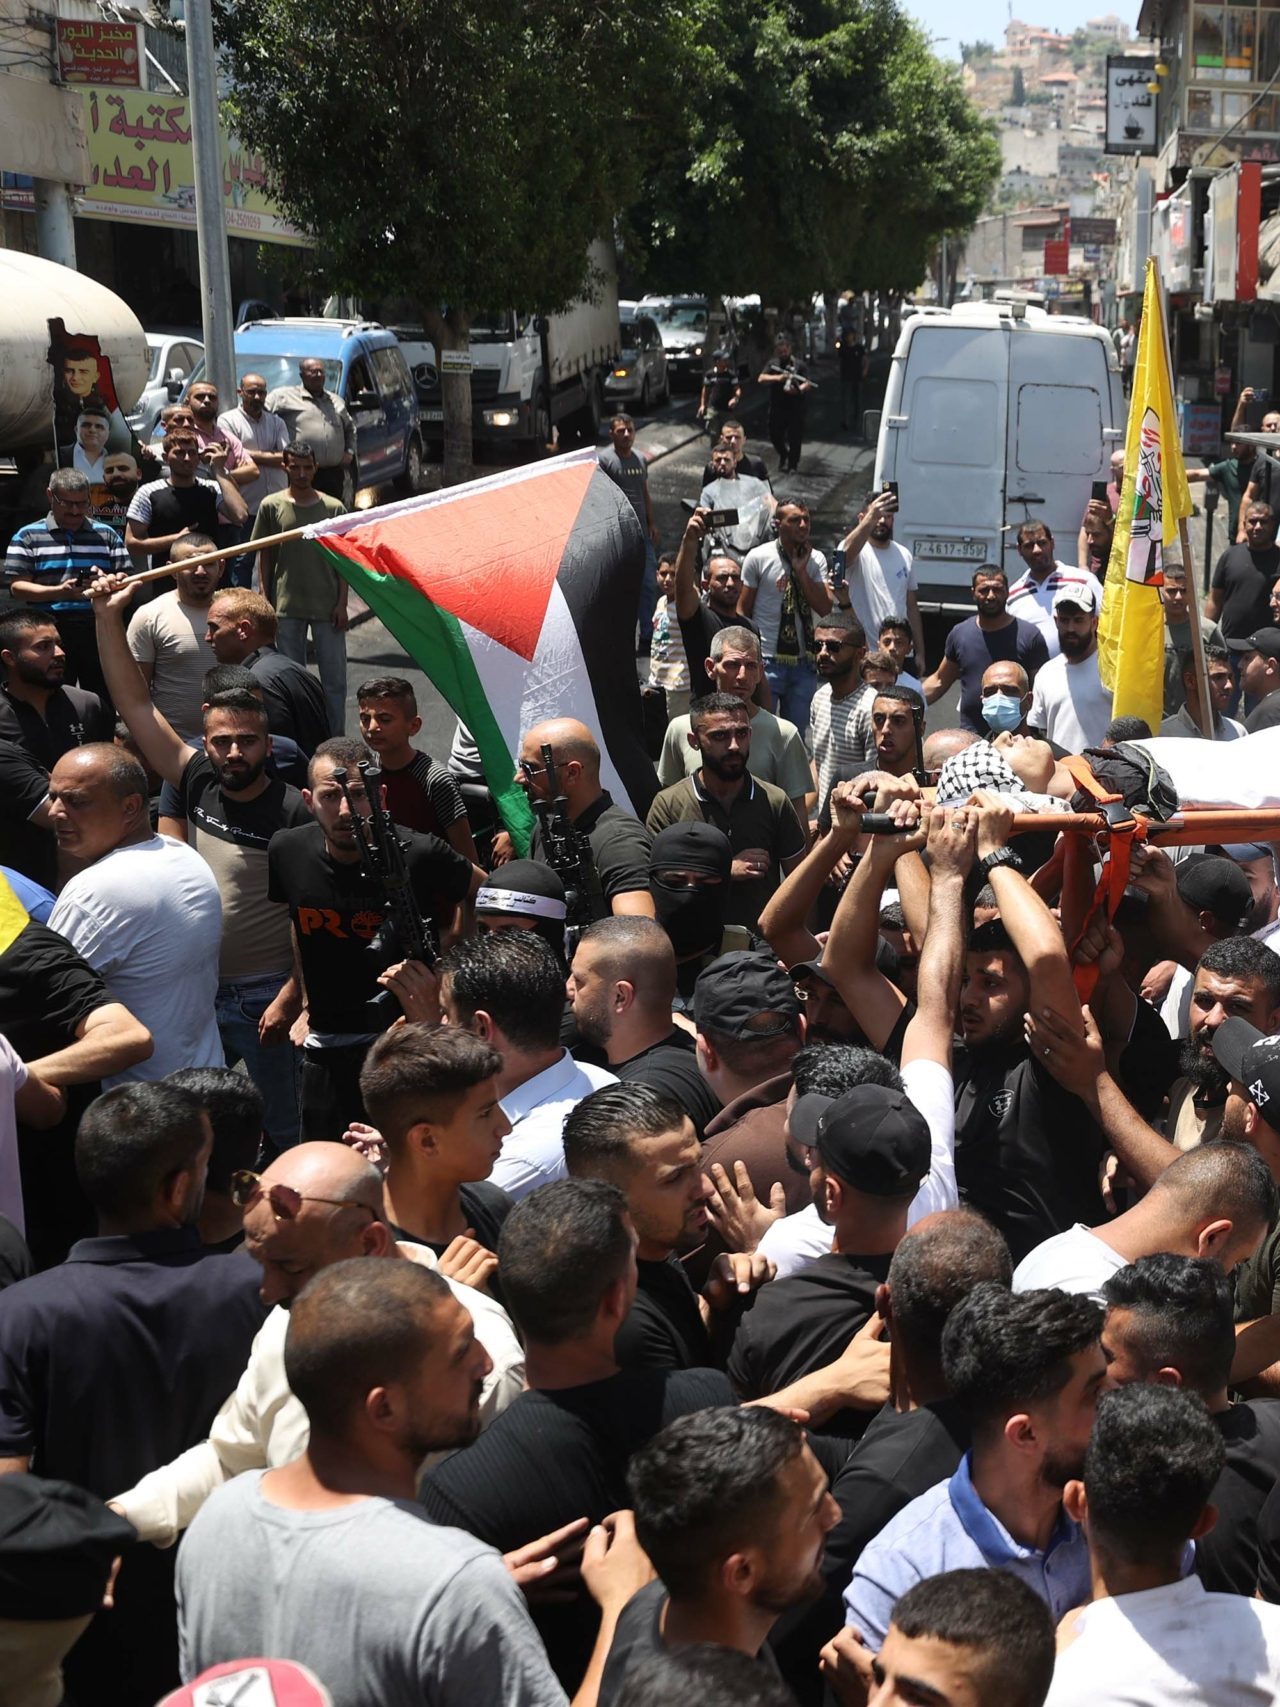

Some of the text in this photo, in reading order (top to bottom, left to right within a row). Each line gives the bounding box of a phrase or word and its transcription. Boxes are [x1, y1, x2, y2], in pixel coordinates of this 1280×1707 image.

[61, 24, 133, 42] مخبز النور
[74, 43, 123, 62] الحديث
